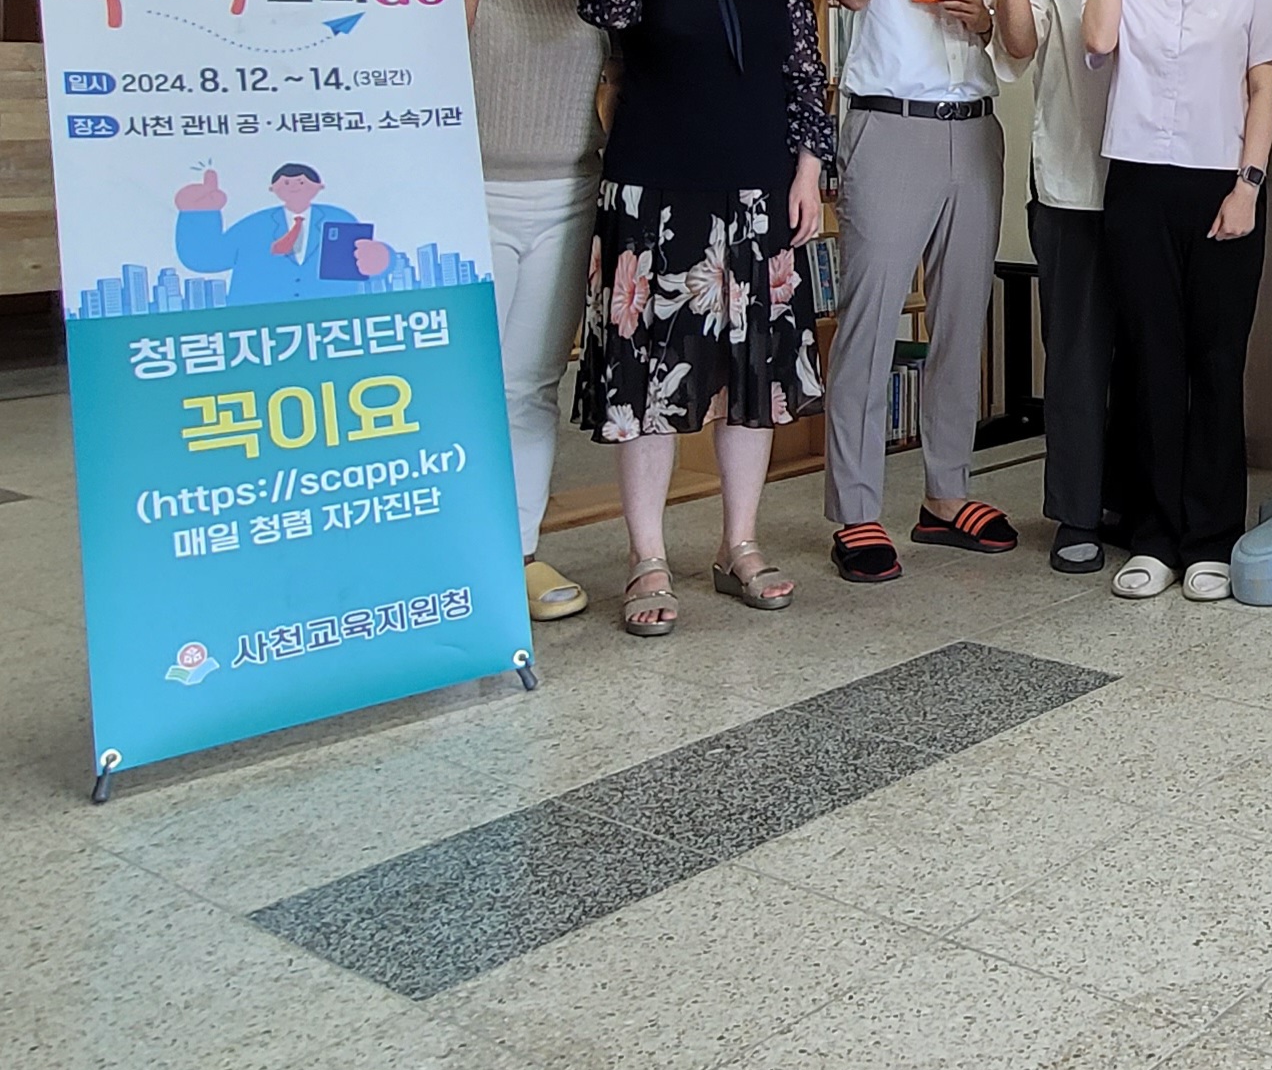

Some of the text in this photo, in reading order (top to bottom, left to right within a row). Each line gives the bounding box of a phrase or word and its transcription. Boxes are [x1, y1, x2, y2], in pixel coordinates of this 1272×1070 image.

[69, 74, 108, 92] 일시
[121, 73, 193, 94] 2024.
[200, 67, 229, 93] 8.
[235, 67, 278, 93] 12.
[73, 118, 115, 136] 장소
[124, 115, 175, 137] 사천
[180, 114, 230, 136] 관내
[378, 106, 463, 130] 소속기관
[128, 308, 451, 381] 청렴자가진단앱
[181, 375, 420, 459] 꼭이요
[135, 443, 468, 526] (https://scapp.kr)
[172, 487, 442, 559] 매일 청렴 자가진단
[231, 587, 474, 670] 사천교육지원청
